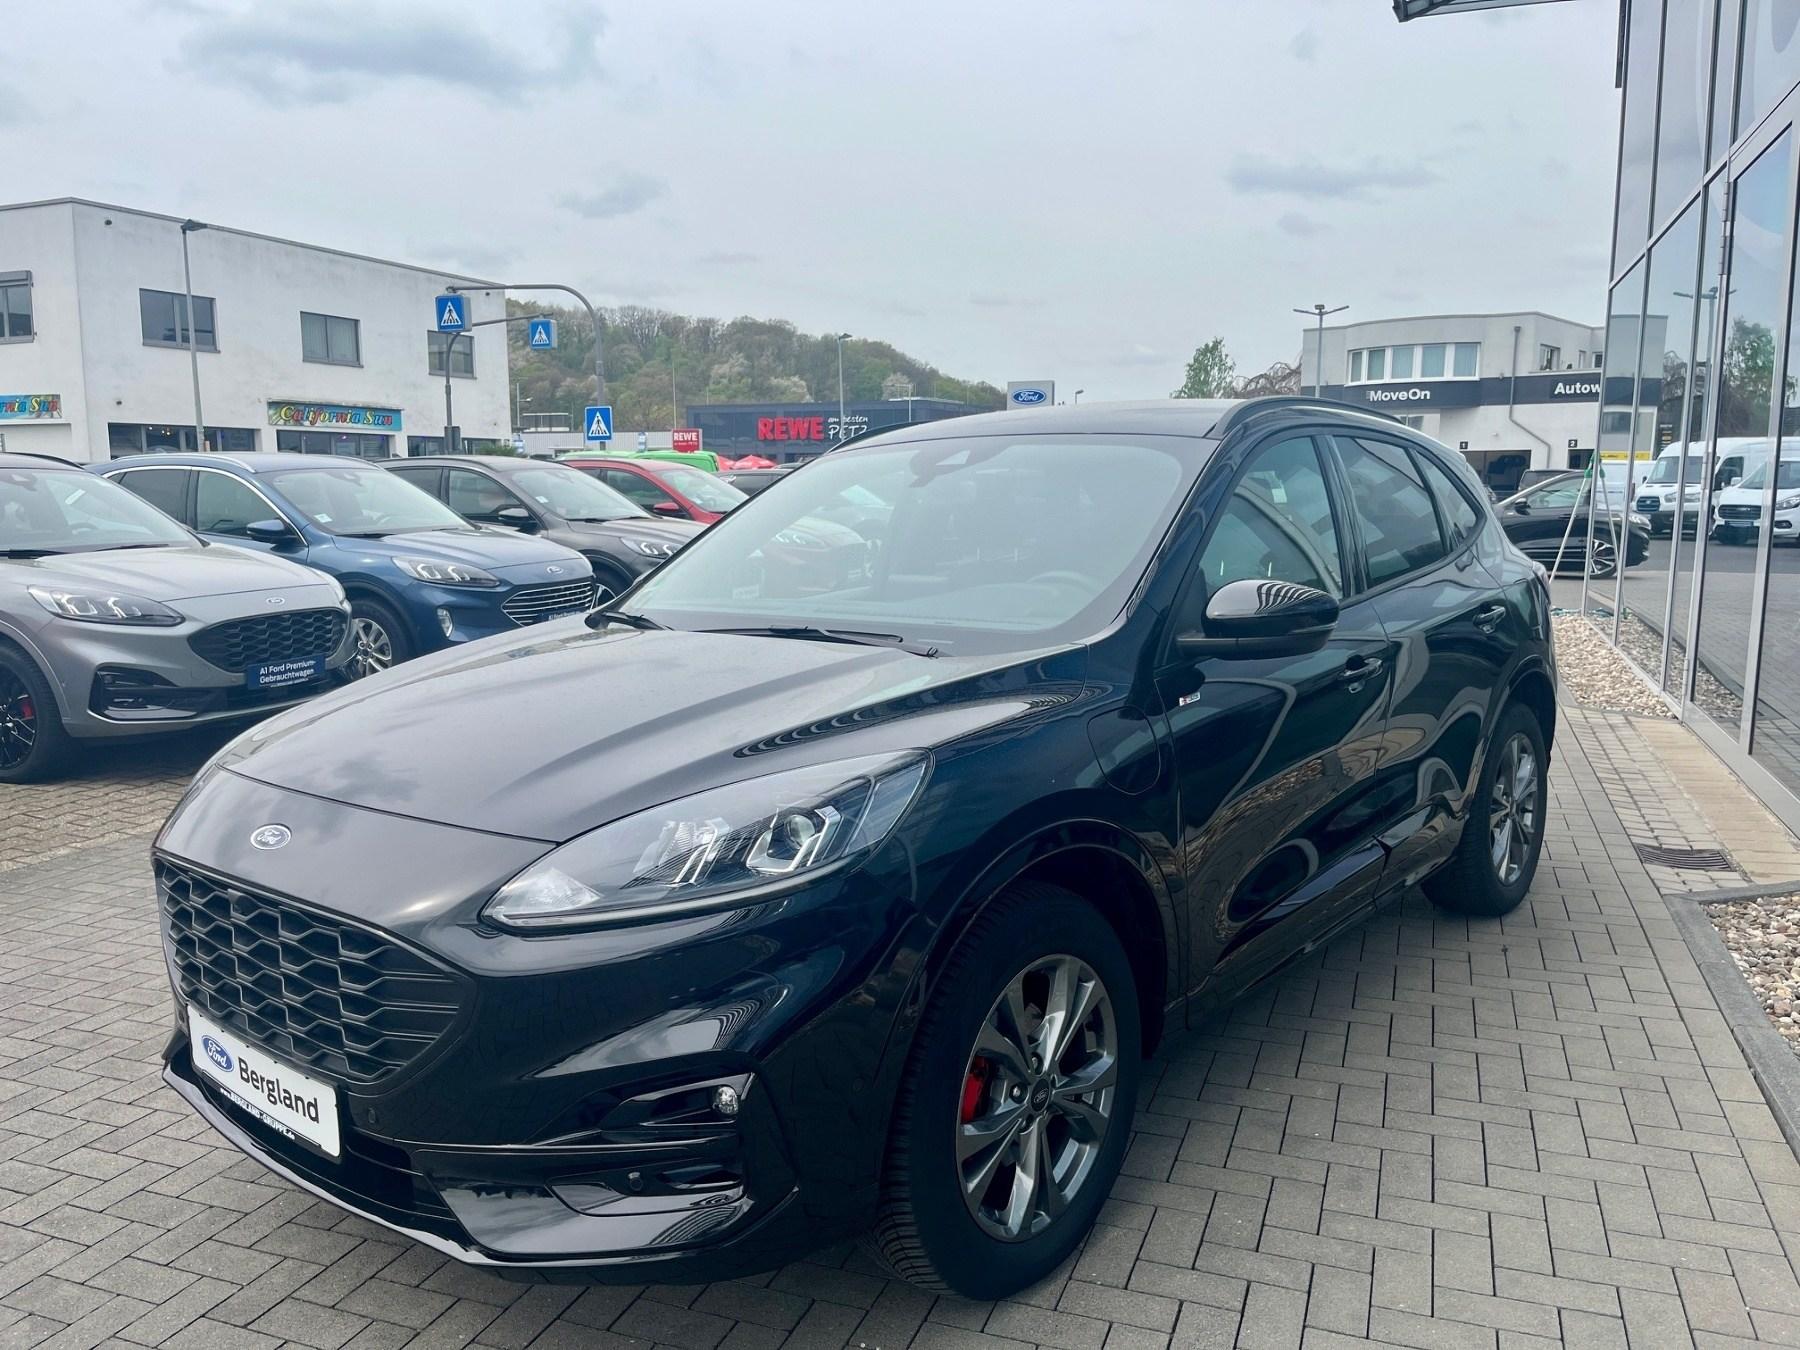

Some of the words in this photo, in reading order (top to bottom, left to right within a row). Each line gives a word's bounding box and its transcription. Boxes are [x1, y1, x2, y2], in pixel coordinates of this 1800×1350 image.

[1018, 391, 1040, 401] Ford
[1370, 388, 1431, 402] MoveOn
[30, 397, 58, 412] Sun
[280, 404, 361, 425] California
[364, 410, 393, 426] Sun
[673, 431, 698, 441] REWE
[758, 416, 824, 440] REWE
[259, 666, 268, 675] A1
[269, 663, 285, 673] Ford
[259, 668, 315, 684] Gebrauchtwagen
[256, 829, 282, 845] Ford
[207, 1040, 228, 1068] Ford
[237, 1056, 320, 1124] Bergland
